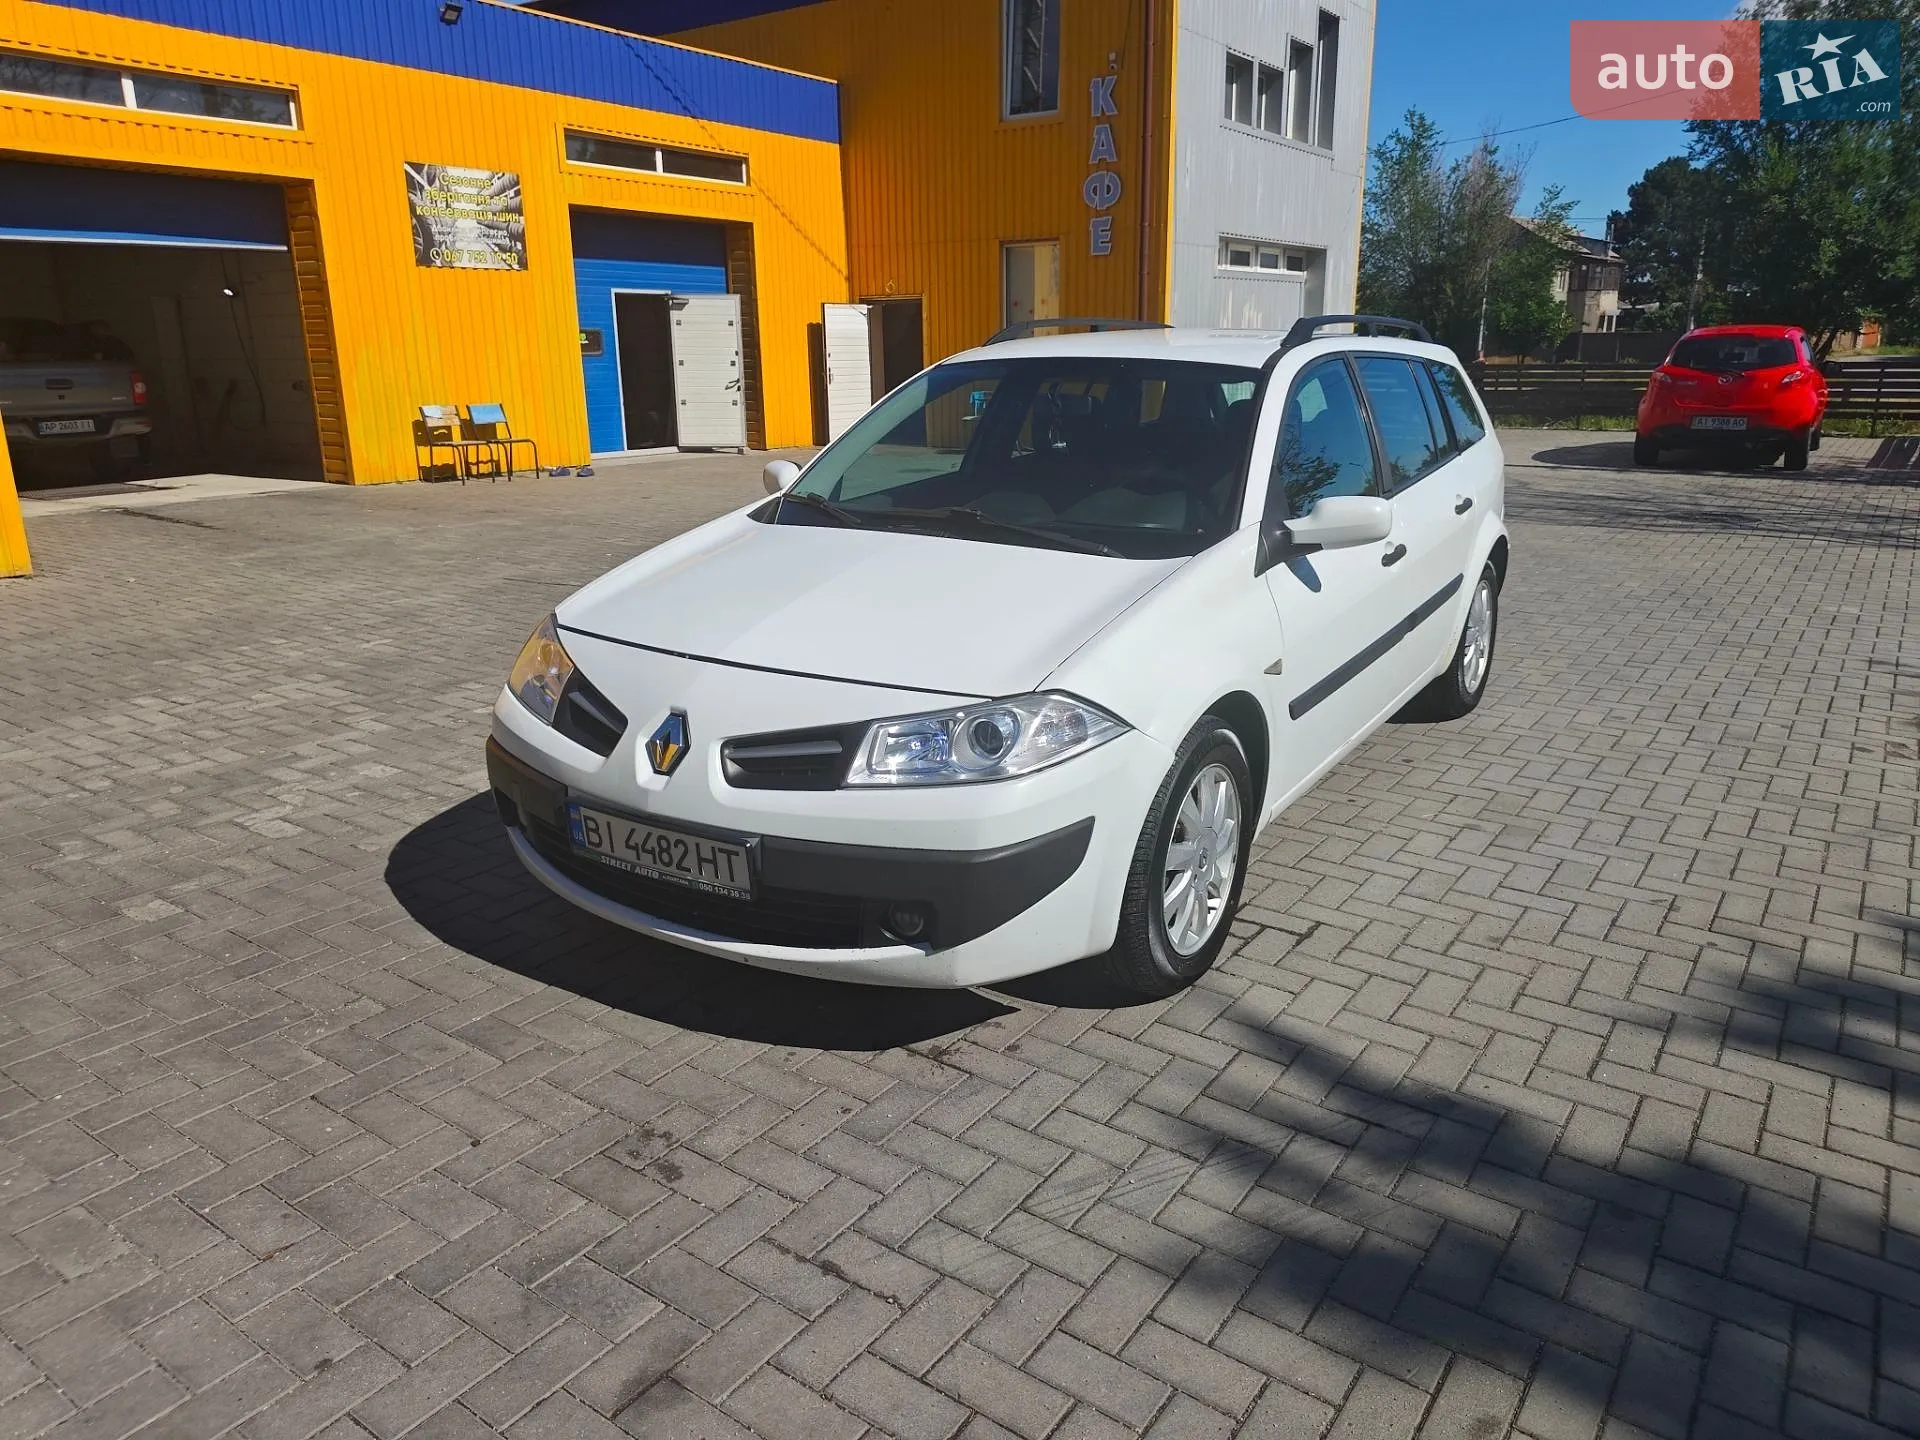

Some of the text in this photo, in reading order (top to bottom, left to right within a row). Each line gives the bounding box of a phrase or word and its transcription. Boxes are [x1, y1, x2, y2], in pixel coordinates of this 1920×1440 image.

[1083, 75, 1121, 256] КАФЕ
[440, 172, 491, 188] Сезонне
[424, 188, 490, 206] зберігання
[416, 205, 519, 222] консервація шин
[444, 250, 465, 262] 067
[467, 250, 487, 264] 752
[505, 252, 518, 265] 50
[574, 830, 585, 842] UA
[583, 815, 739, 882] BI 4482 HT
[601, 855, 631, 872] STREET
[634, 866, 659, 880] AUTO
